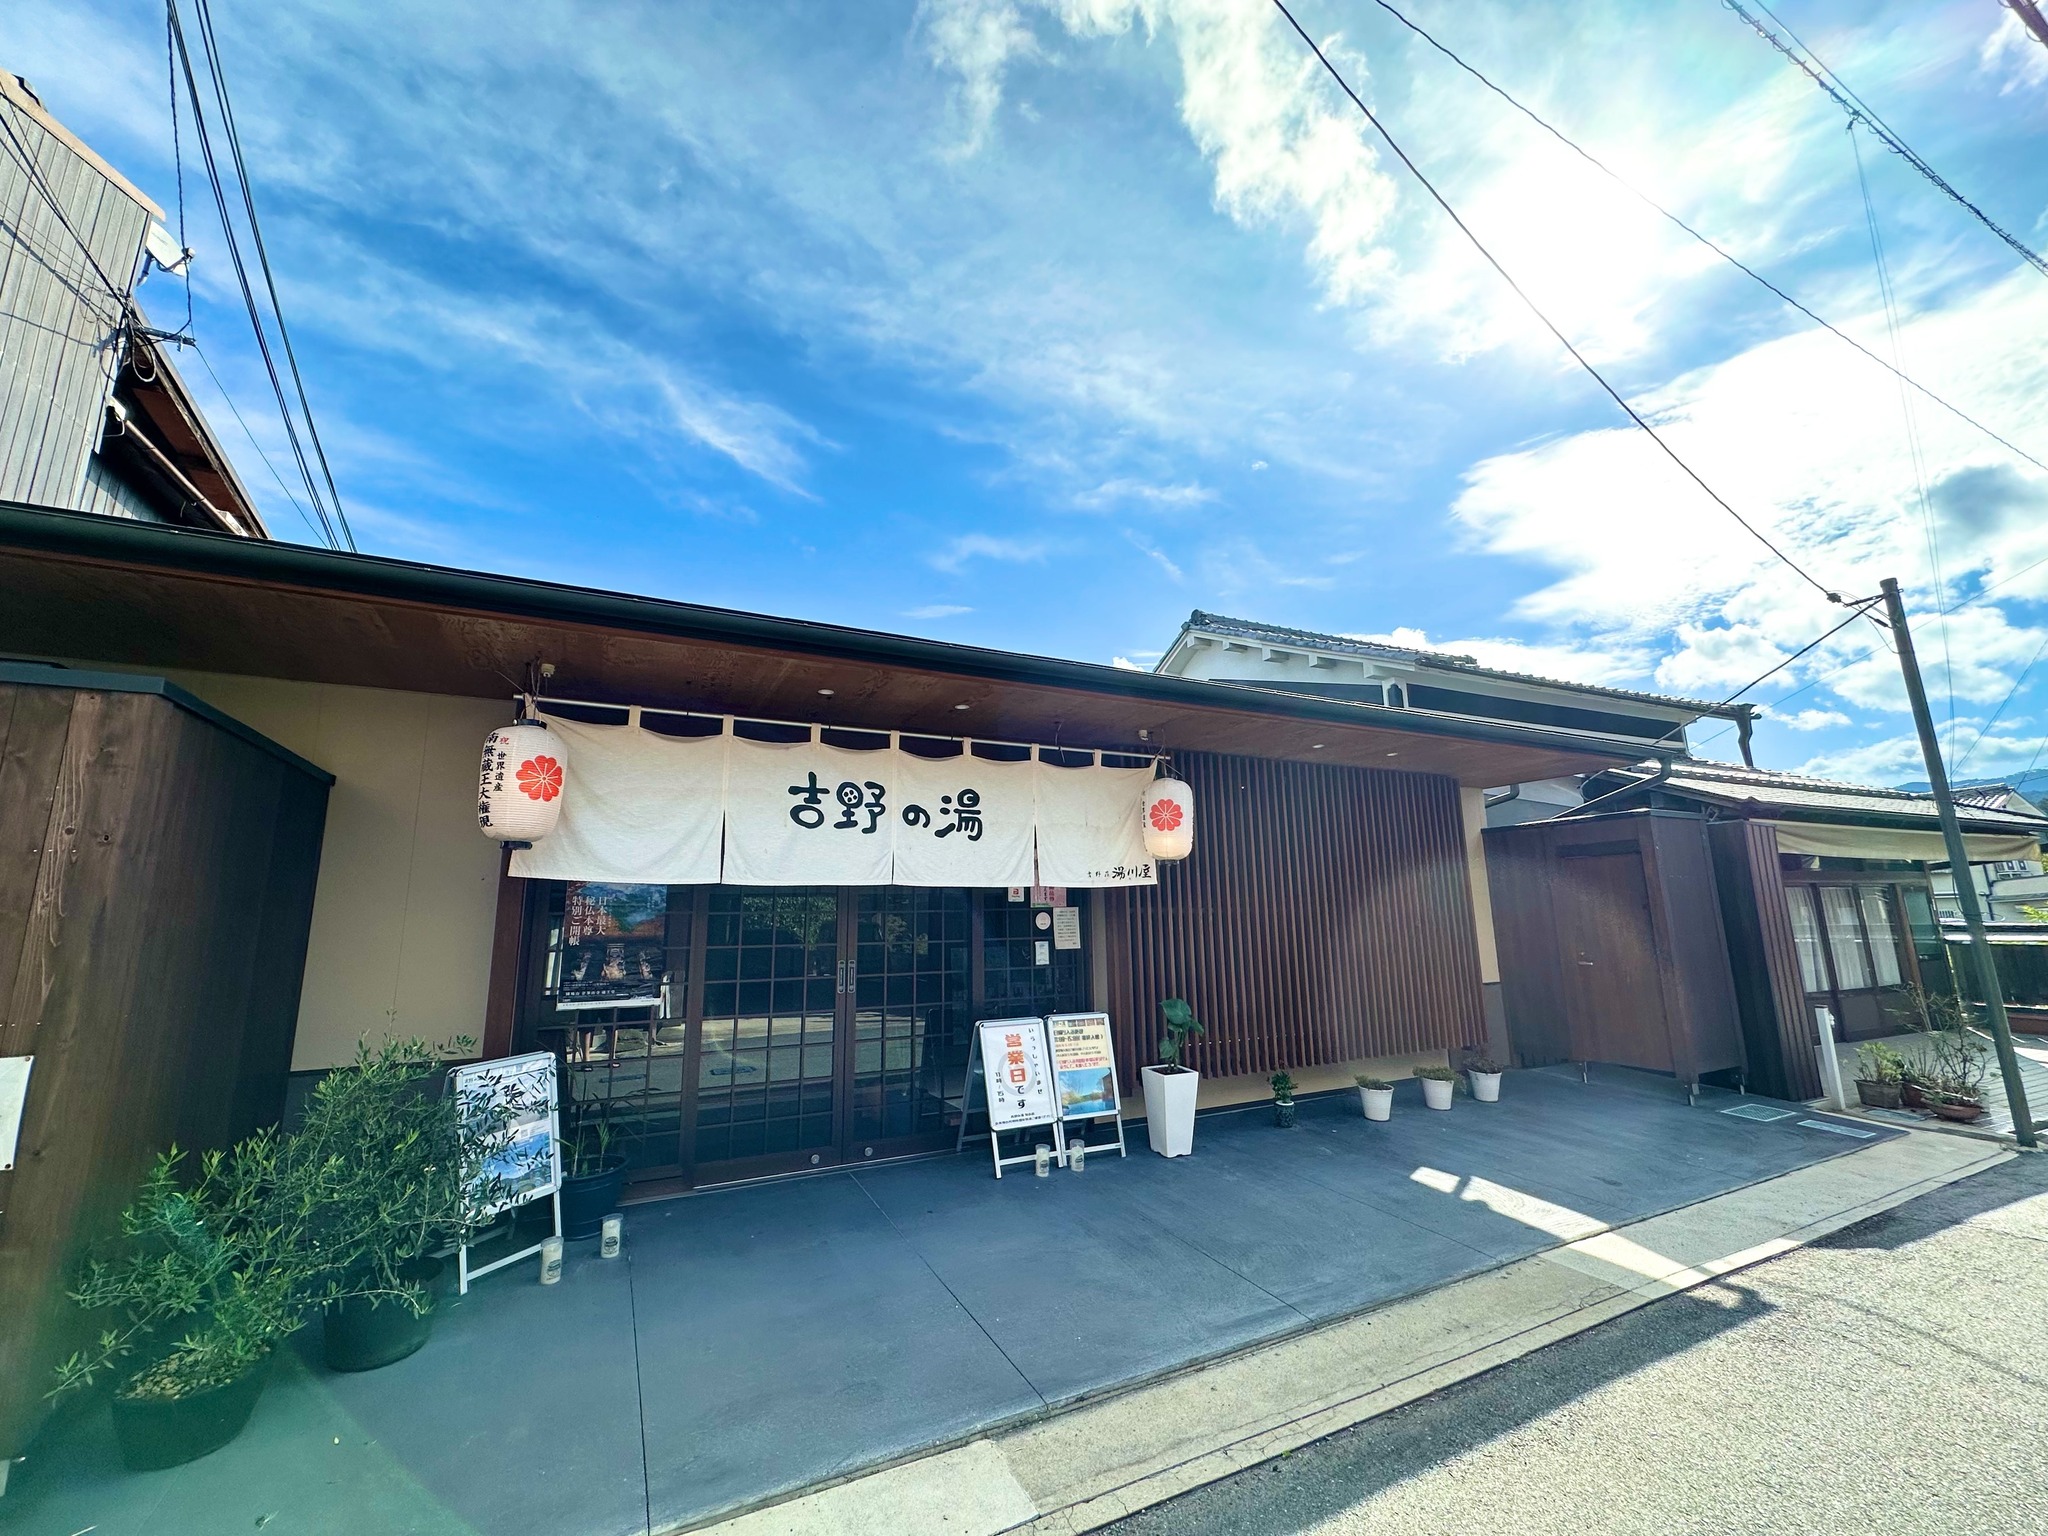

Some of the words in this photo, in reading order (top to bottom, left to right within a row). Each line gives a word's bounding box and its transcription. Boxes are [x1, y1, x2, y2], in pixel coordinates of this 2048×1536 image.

[492, 750, 507, 792] 世界遺産
[788, 771, 984, 842] 吉野の湯
[1111, 863, 1152, 880] 湯川屋
[568, 895, 583, 946] 特別ご開帳
[582, 896, 596, 936] 秘仏本尊
[595, 896, 608, 936] 日本最大
[1004, 1033, 1027, 1109] 営業日です
[1027, 1027, 1043, 1095] いらっしゃいませ
